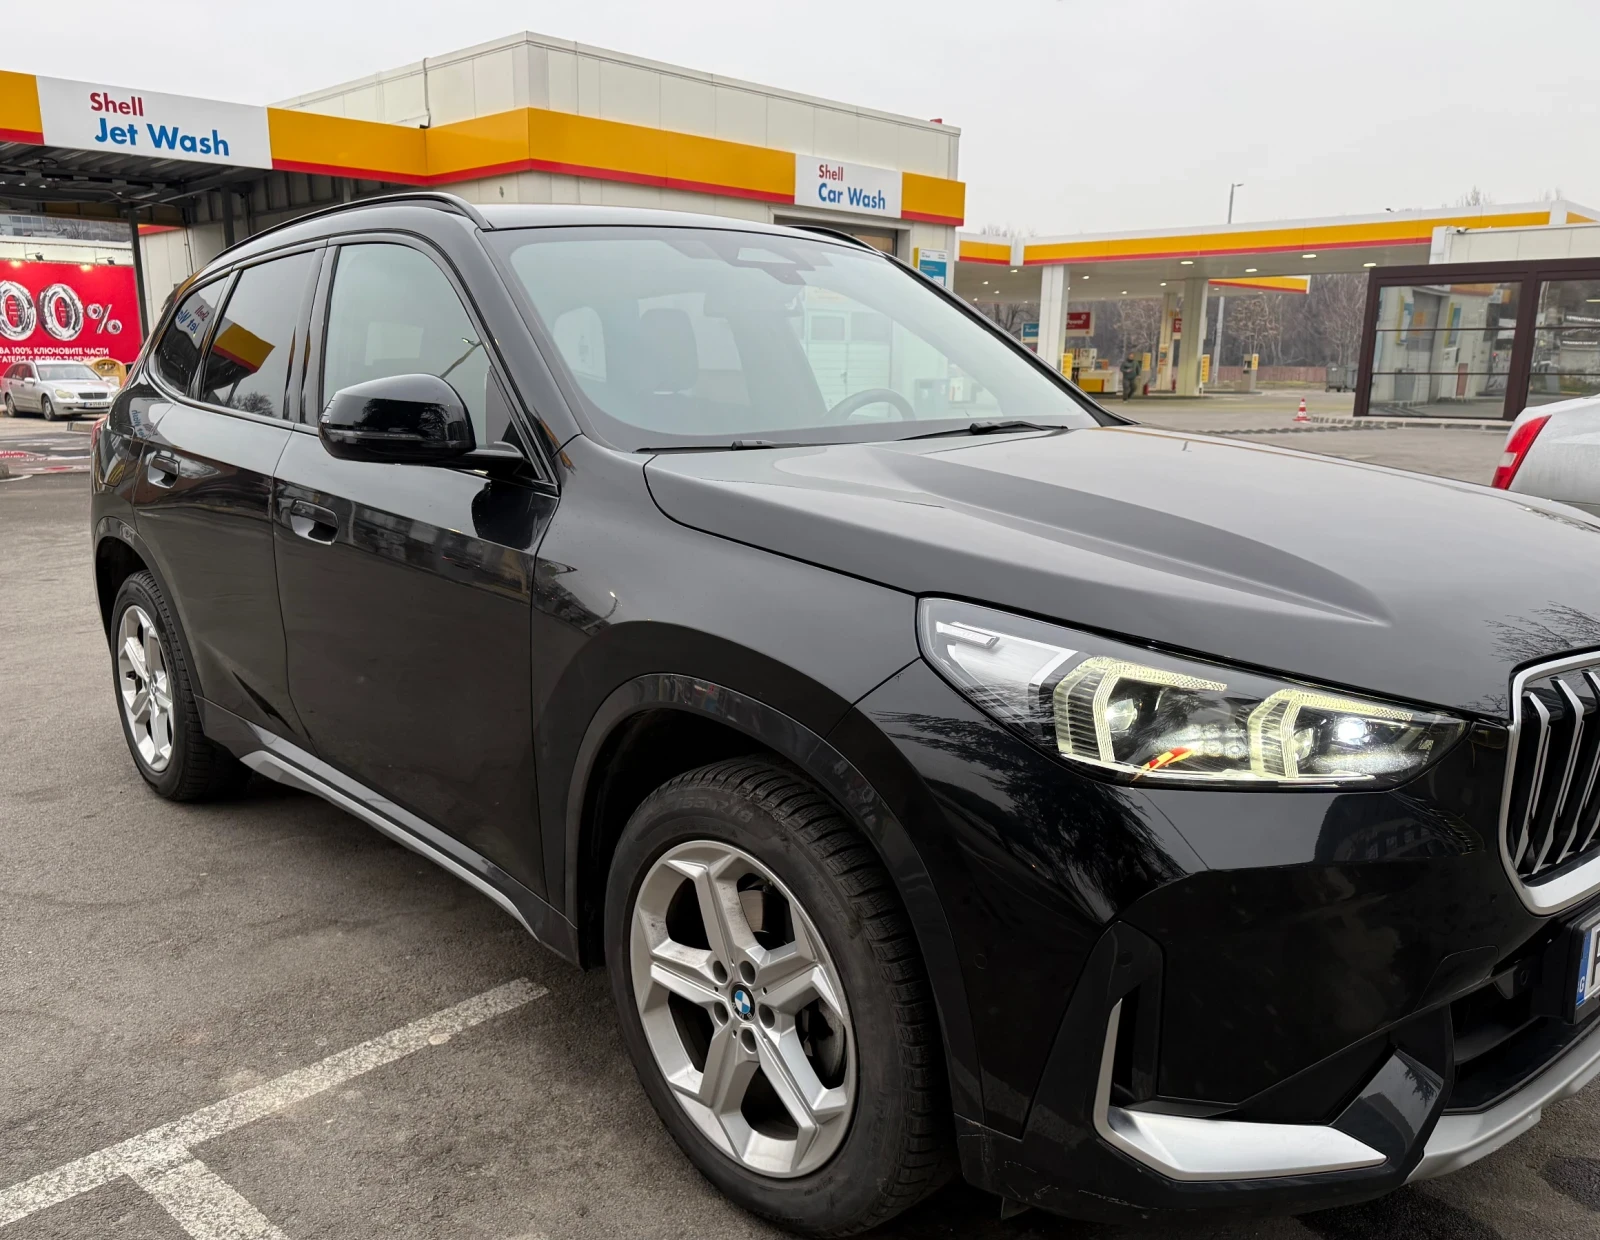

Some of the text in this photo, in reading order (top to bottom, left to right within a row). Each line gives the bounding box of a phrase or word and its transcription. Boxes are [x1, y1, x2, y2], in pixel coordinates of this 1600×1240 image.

[90, 92, 144, 117] Shell
[94, 117, 230, 156] Jet Wash
[818, 164, 844, 182] Shell
[818, 182, 886, 210] Car Wash
[11, 346, 33, 355] 100%
[33, 346, 84, 355] КЛЮЧОВИТЕ
[84, 347, 110, 355] ЧАСТИ
